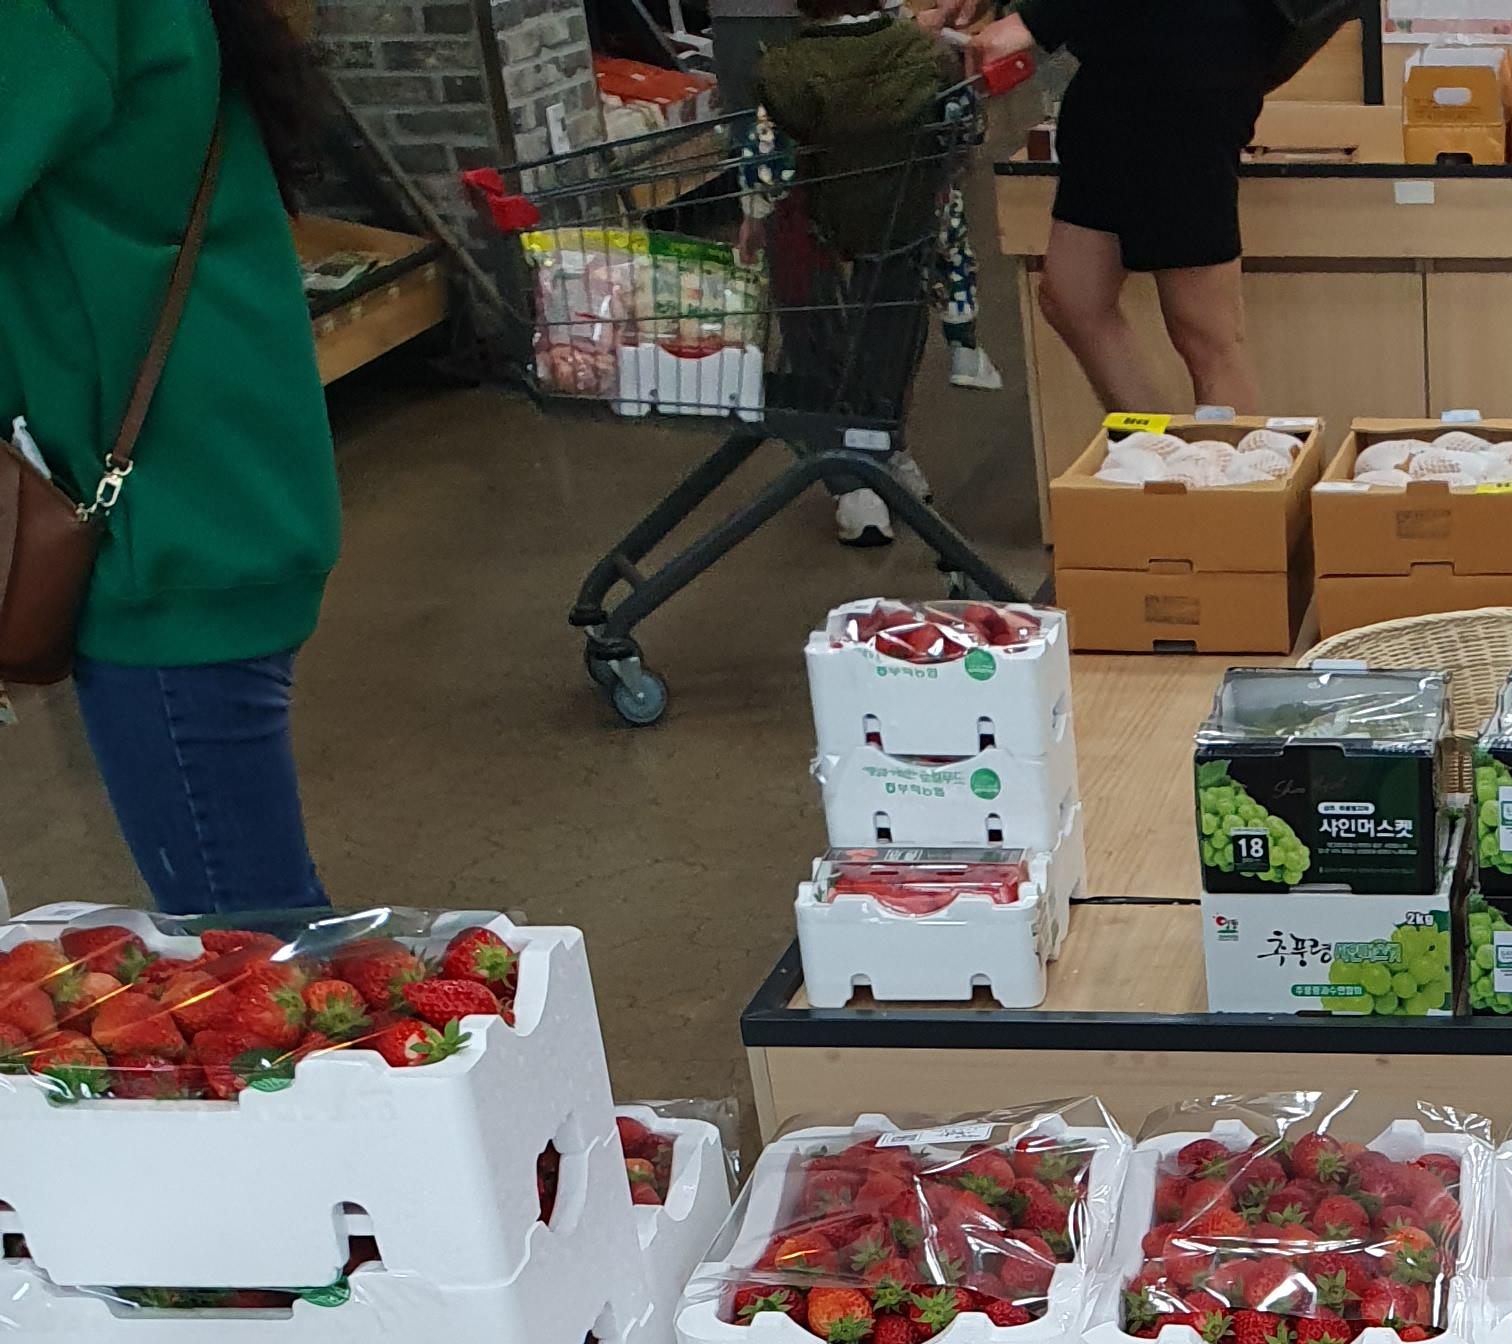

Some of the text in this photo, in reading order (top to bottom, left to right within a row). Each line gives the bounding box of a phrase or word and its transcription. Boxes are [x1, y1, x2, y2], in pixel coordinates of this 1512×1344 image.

[1318, 818, 1414, 839] 샤인머스켓
[1237, 838, 1264, 858] 18
[1405, 911, 1434, 926] 2kg
[1257, 930, 1333, 967] 추풍령
